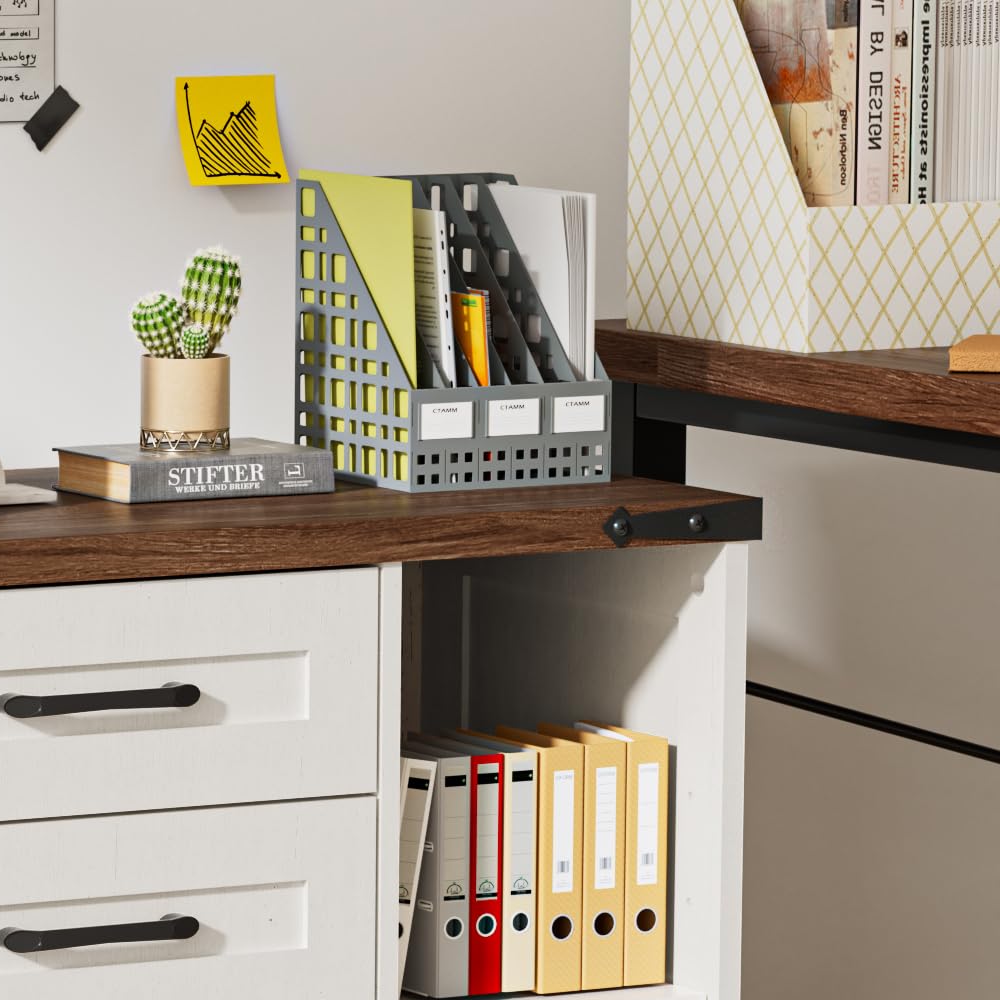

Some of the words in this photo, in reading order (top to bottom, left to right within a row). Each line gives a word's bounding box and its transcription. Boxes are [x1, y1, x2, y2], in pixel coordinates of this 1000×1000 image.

[19, 91, 40, 100] tech
[168, 463, 265, 486] STIFTER
[175, 484, 207, 493] WERKE
[209, 483, 227, 492] UND
[229, 481, 261, 491] BRIEFE
